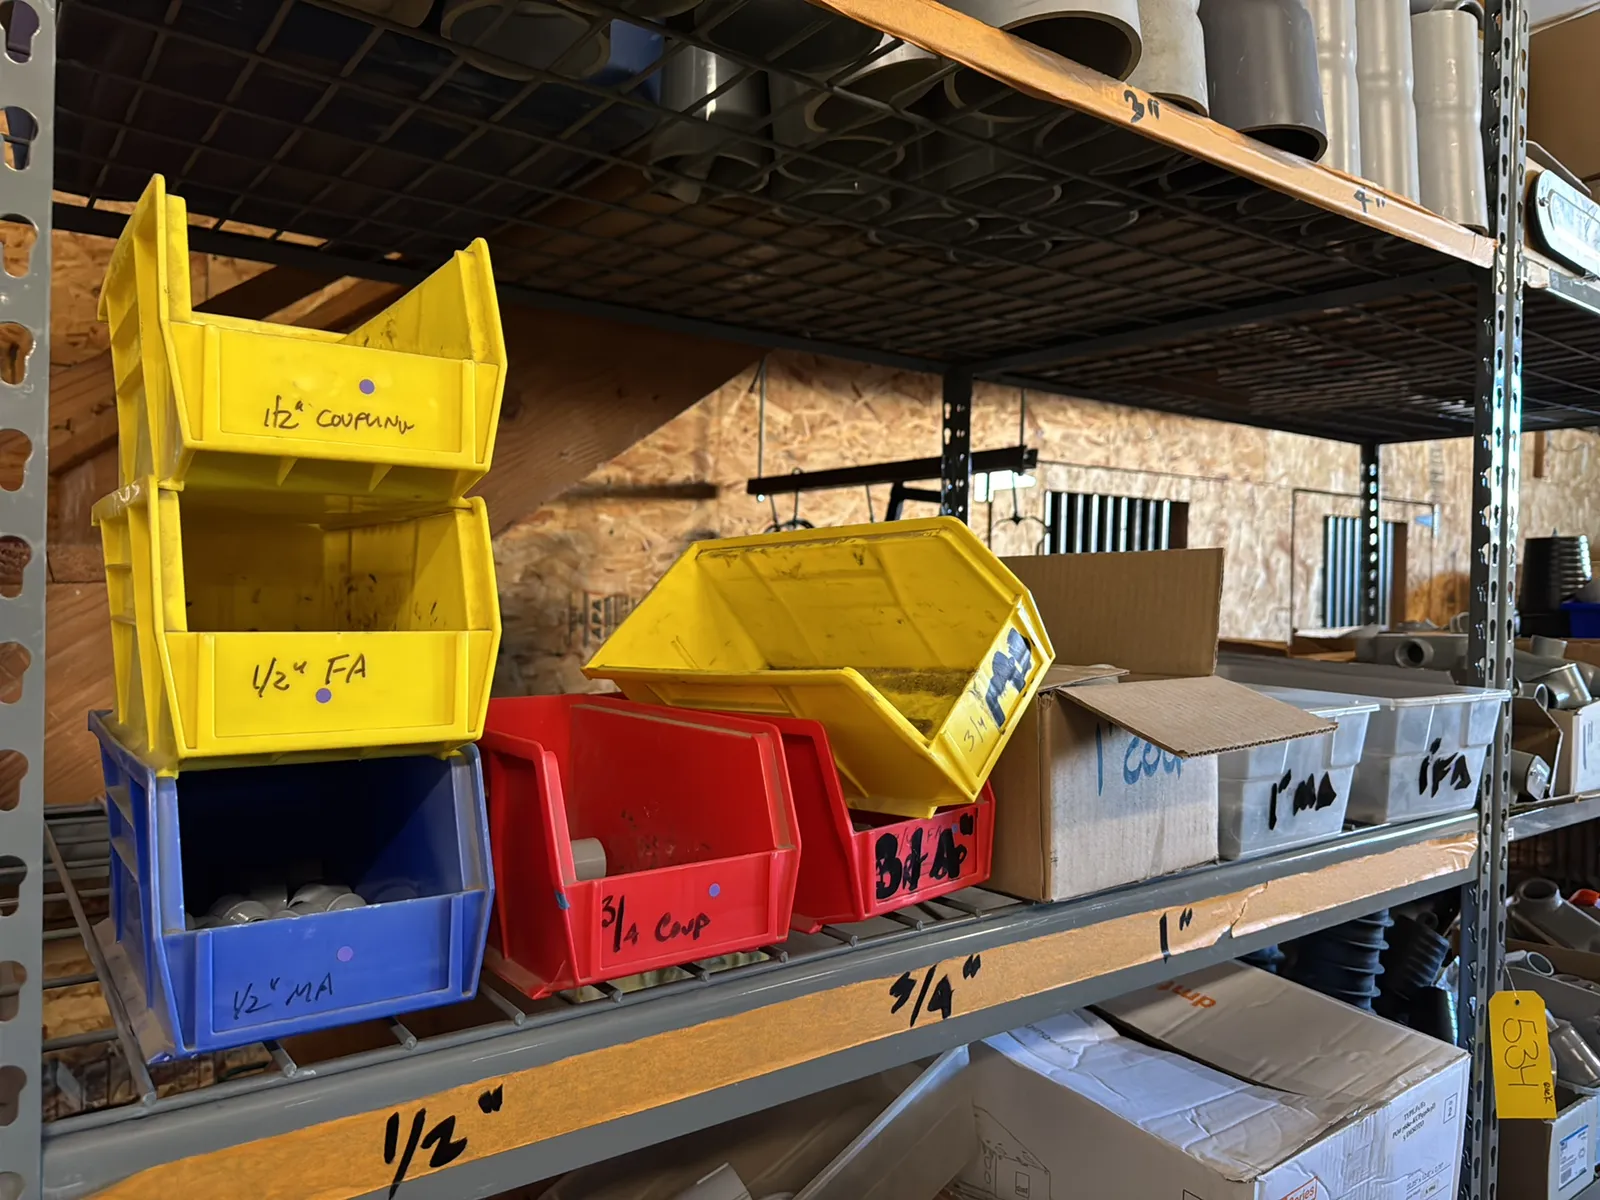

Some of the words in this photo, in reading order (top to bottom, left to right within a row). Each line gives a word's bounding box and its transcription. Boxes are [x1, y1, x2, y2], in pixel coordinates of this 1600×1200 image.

[1124, 90, 1159, 123] 3"
[253, 656, 307, 698] 1/2"
[325, 653, 366, 685] FA
[602, 895, 639, 953] 3/4
[285, 972, 333, 1006] MA
[1503, 1018, 1539, 1087] 534
[384, 1084, 503, 1200] 1/2"
